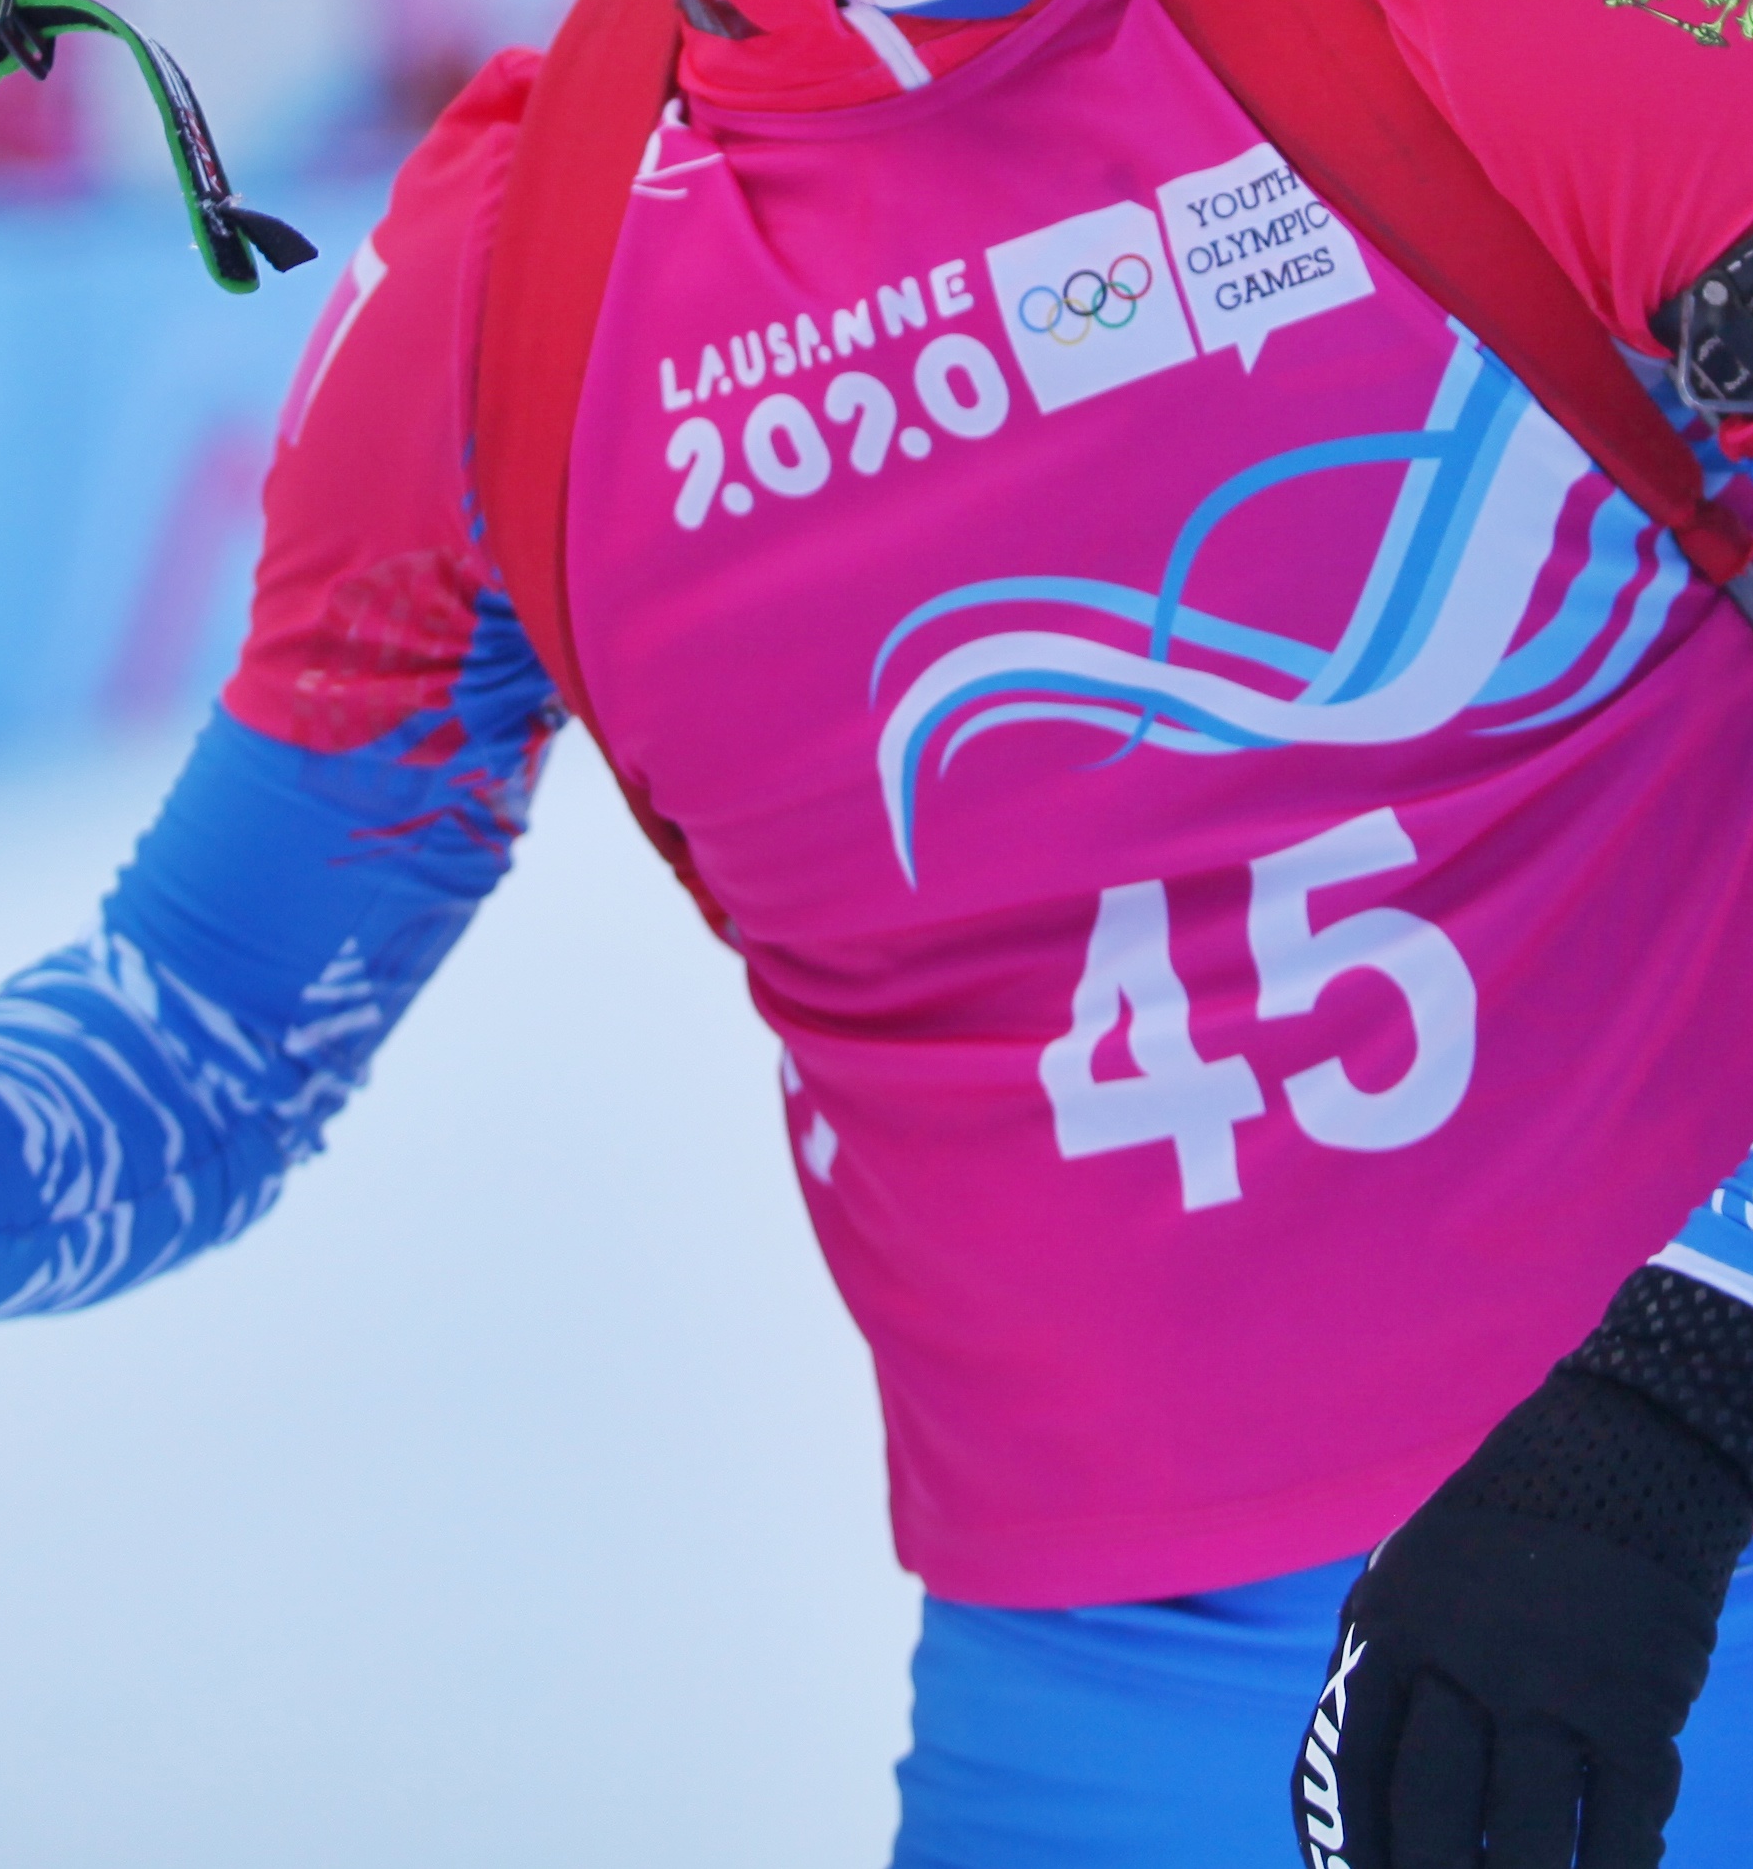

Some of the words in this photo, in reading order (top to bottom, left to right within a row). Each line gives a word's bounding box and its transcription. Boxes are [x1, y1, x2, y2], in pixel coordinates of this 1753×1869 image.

[1187, 164, 1300, 228] YOUTH
[1187, 200, 1330, 275] OLYMPIC
[1214, 246, 1336, 311] GAMES
[659, 257, 976, 413] LAUSANNE
[1037, 806, 1478, 1214] 45
